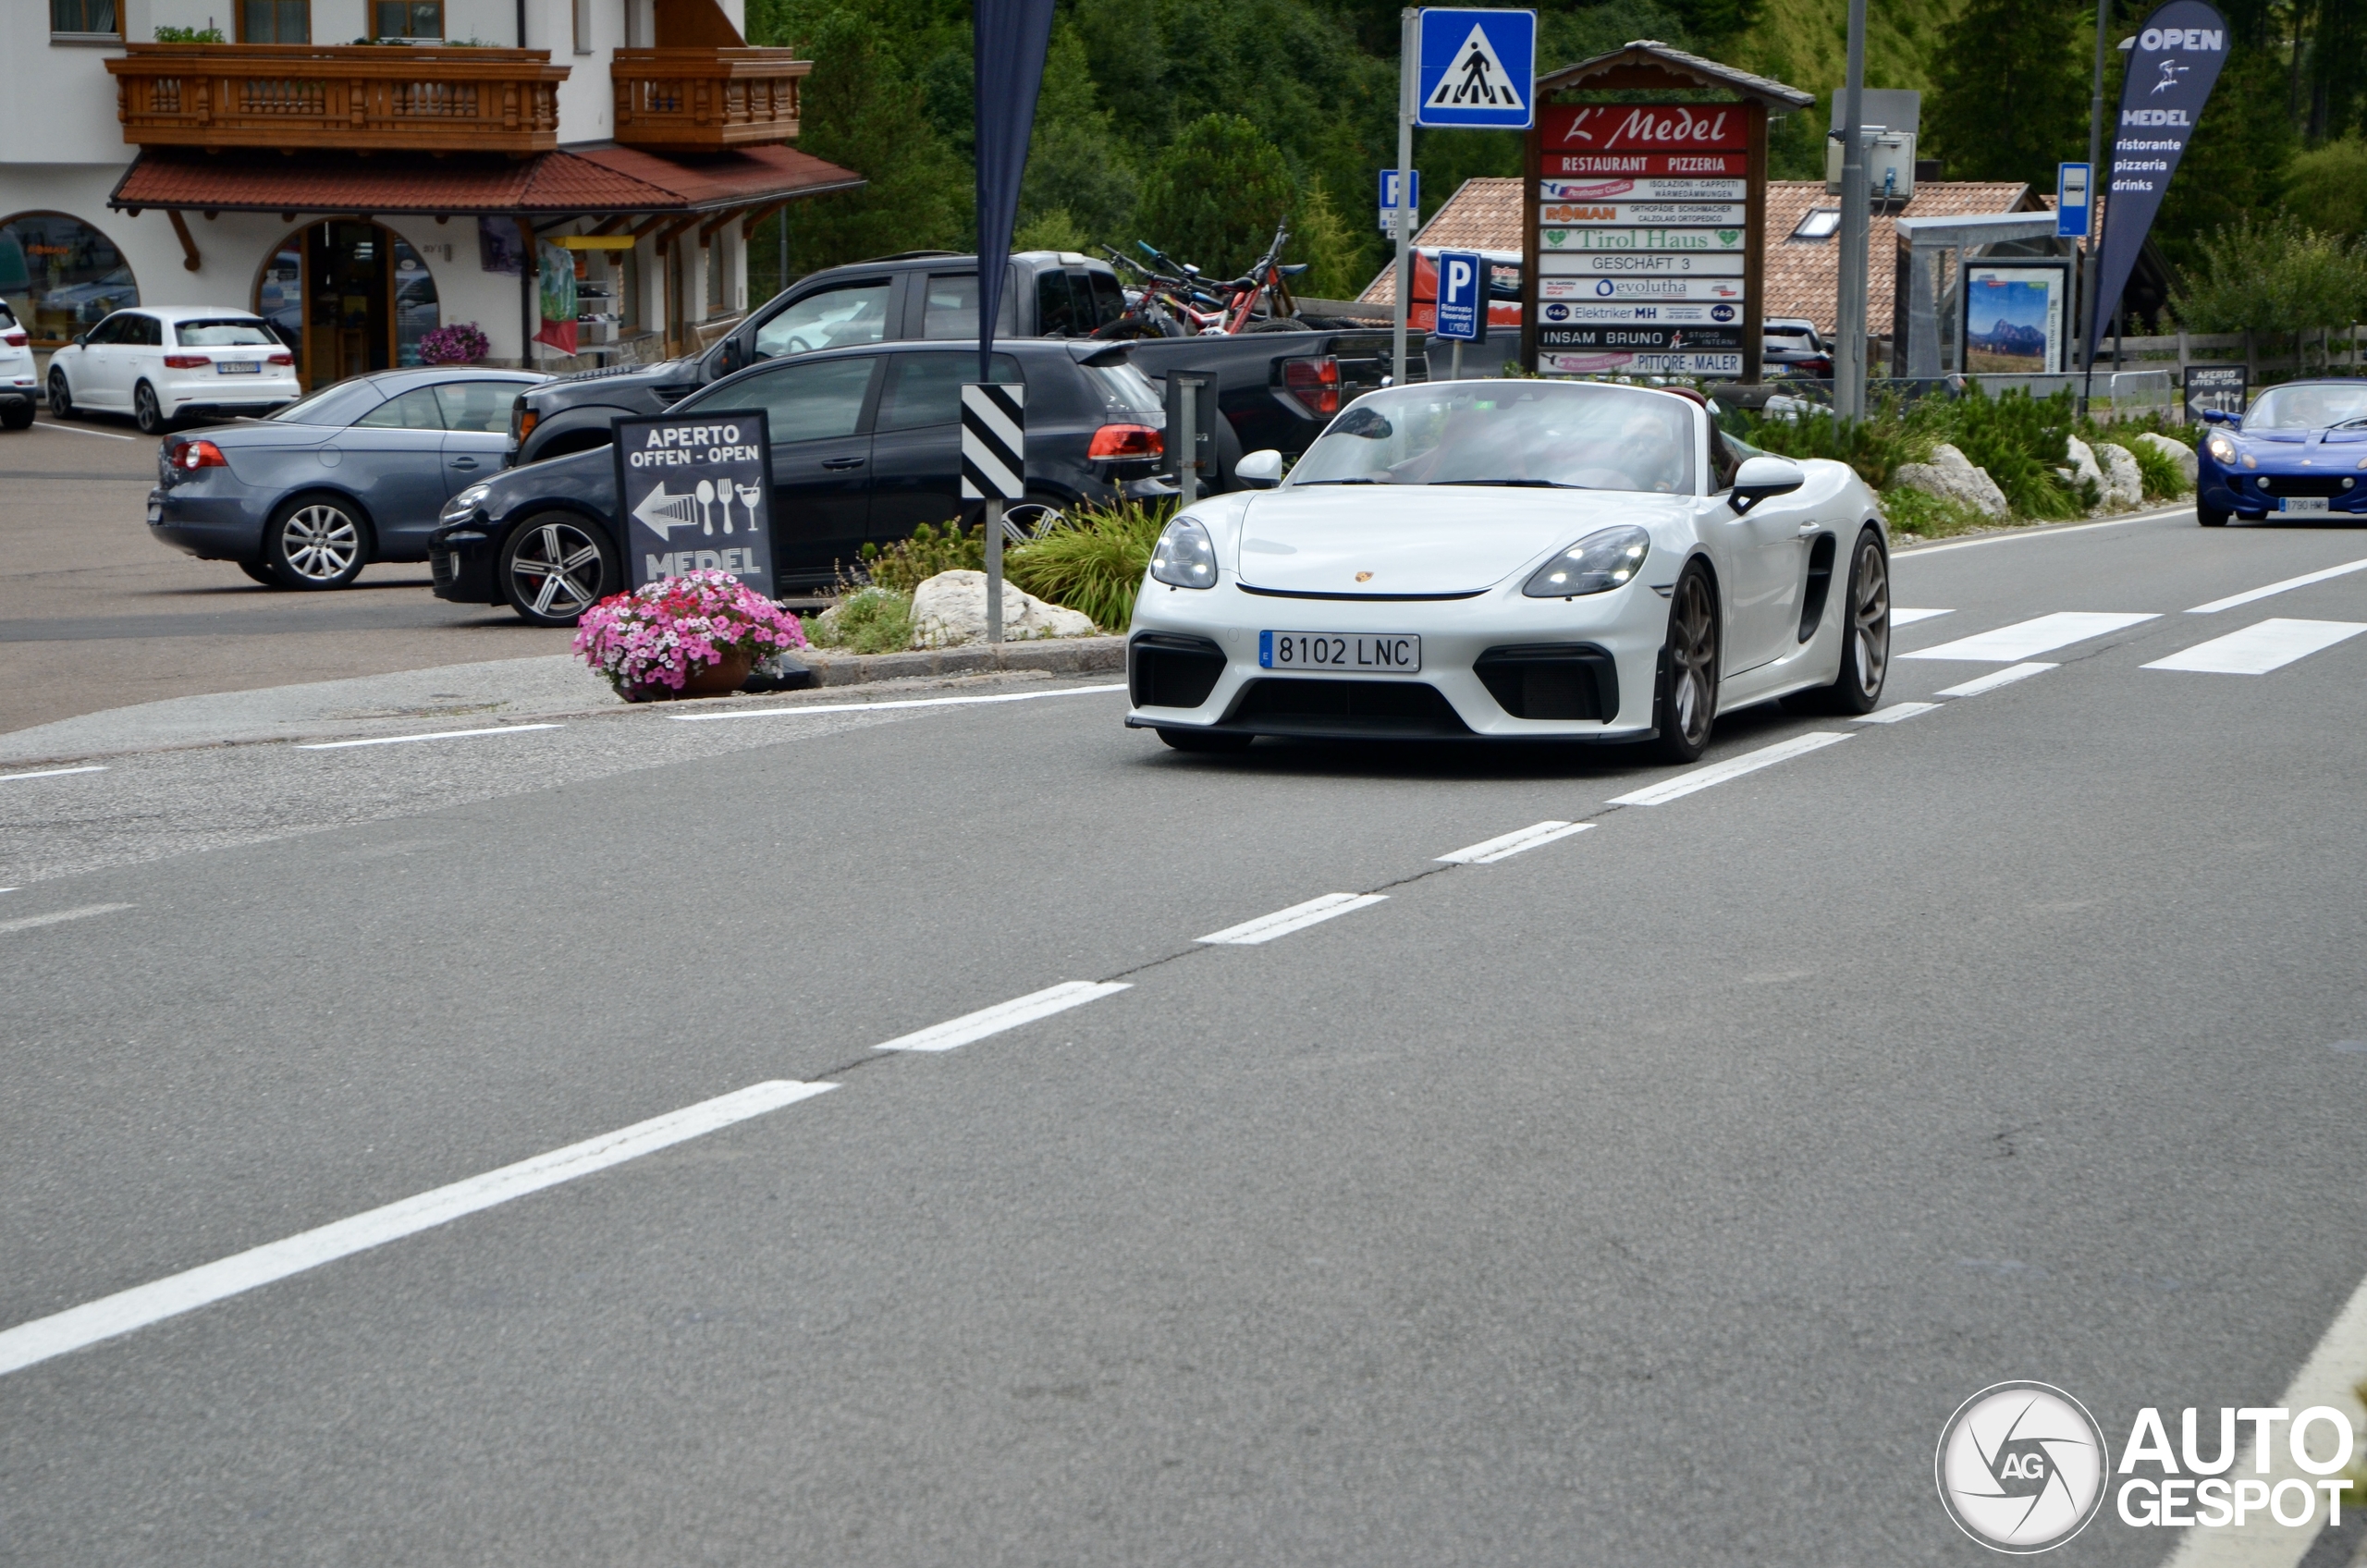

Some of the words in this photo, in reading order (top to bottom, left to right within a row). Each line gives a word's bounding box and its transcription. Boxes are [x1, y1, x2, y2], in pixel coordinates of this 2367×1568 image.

[2140, 28, 2223, 51] OPEN
[2121, 109, 2190, 126] MEDEL
[1604, 107, 1727, 149] Medel
[2116, 139, 2182, 151] ristorante
[1563, 157, 1648, 171] RESTAURANT
[1668, 157, 1726, 171] PIZZERIA
[2114, 159, 2167, 173] pizzeria
[1650, 180, 1693, 189] ISOLAZIONI
[1700, 179, 1739, 189] CAPPOTTI
[2112, 179, 2153, 191] drinks
[1545, 204, 1616, 222] ROMAN
[1630, 203, 1674, 213] ORTHOPÄDIE
[1678, 204, 1732, 213] SCHUHMACHER
[1576, 229, 1636, 248] Tirol
[1645, 229, 1709, 248] Haus
[1592, 254, 1674, 270] GESCHÄFT
[1682, 258, 1691, 270] 3
[1447, 260, 1472, 303] P
[1615, 279, 1686, 292] evolutha
[1575, 307, 1633, 319] Elektriker
[1635, 308, 1657, 319] MH
[1544, 332, 1596, 343] INSAM
[1606, 332, 1663, 344] BRUNO
[1638, 355, 1686, 370] PITTORE
[1695, 355, 1737, 370] MALER
[2196, 370, 2236, 379] APERTO
[646, 424, 740, 448] APERTO
[630, 448, 691, 467] OFFEN
[708, 445, 759, 463] OPEN
[2287, 500, 2309, 510] 1790
[645, 547, 761, 581] MEDEL
[1263, 652, 1269, 660] E
[1280, 636, 1346, 665] 8102
[1357, 639, 1409, 666] LNC
